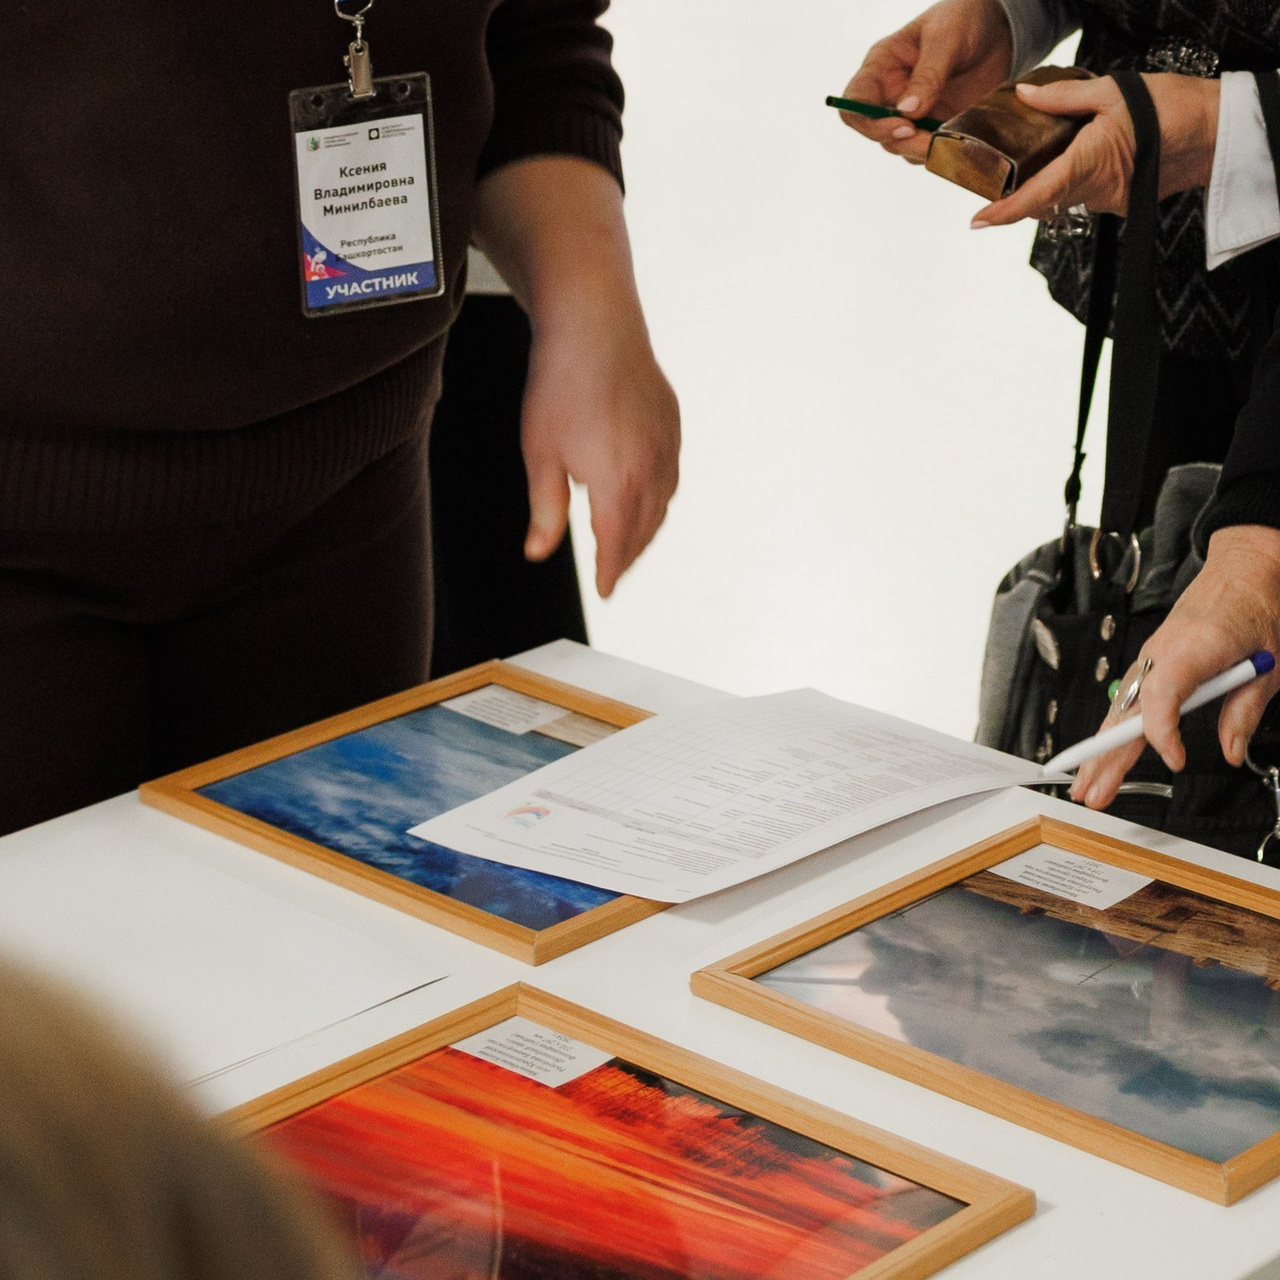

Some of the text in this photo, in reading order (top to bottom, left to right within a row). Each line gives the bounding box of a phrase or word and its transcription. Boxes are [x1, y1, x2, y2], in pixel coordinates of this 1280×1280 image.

[339, 162, 387, 178] Ксения
[314, 176, 415, 200] Владимировна
[323, 195, 408, 216] Минилбаева
[341, 233, 397, 248] Республика
[326, 272, 419, 299] УЧАСТНИК
